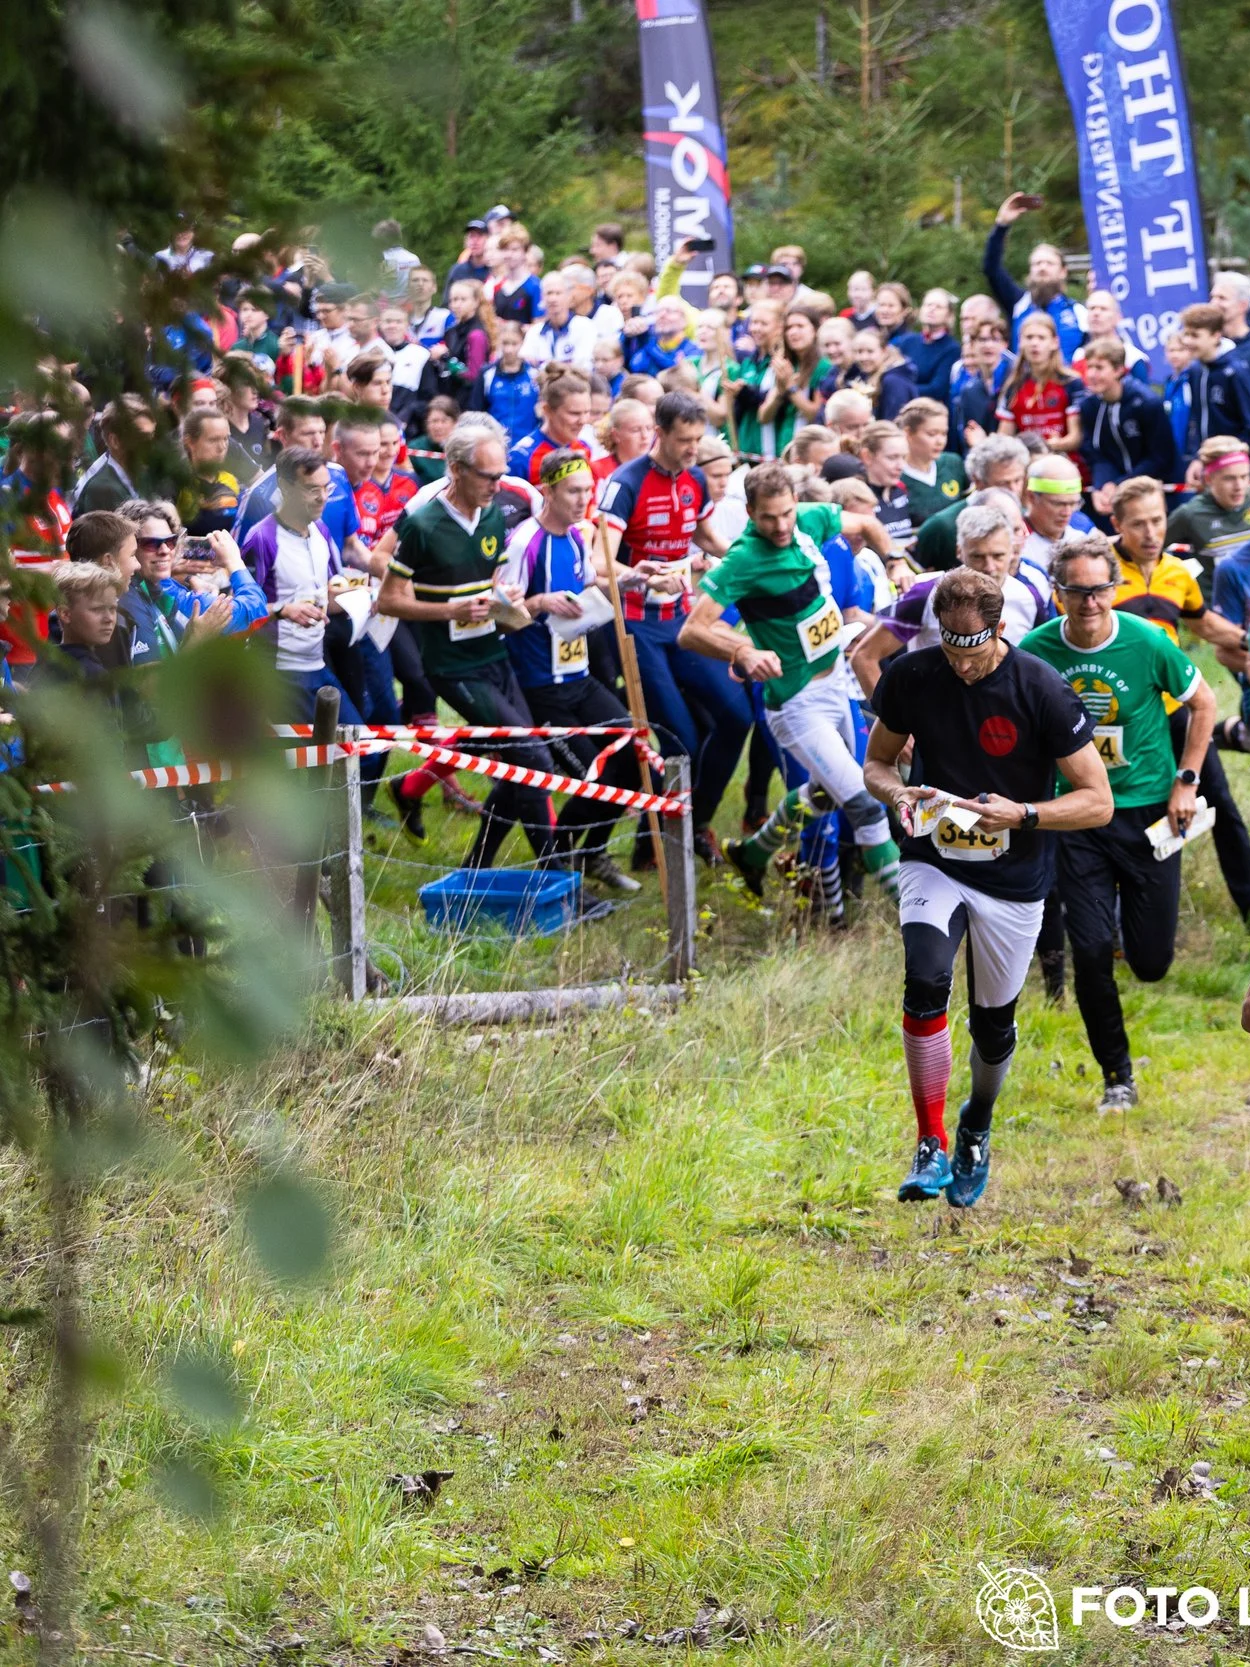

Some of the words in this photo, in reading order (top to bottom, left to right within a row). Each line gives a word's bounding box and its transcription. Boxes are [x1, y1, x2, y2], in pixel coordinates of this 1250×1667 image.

[808, 610, 840, 646] 323
[559, 640, 587, 662] 34
[1105, 669, 1118, 679] IF
[1116, 680, 1130, 692] OF
